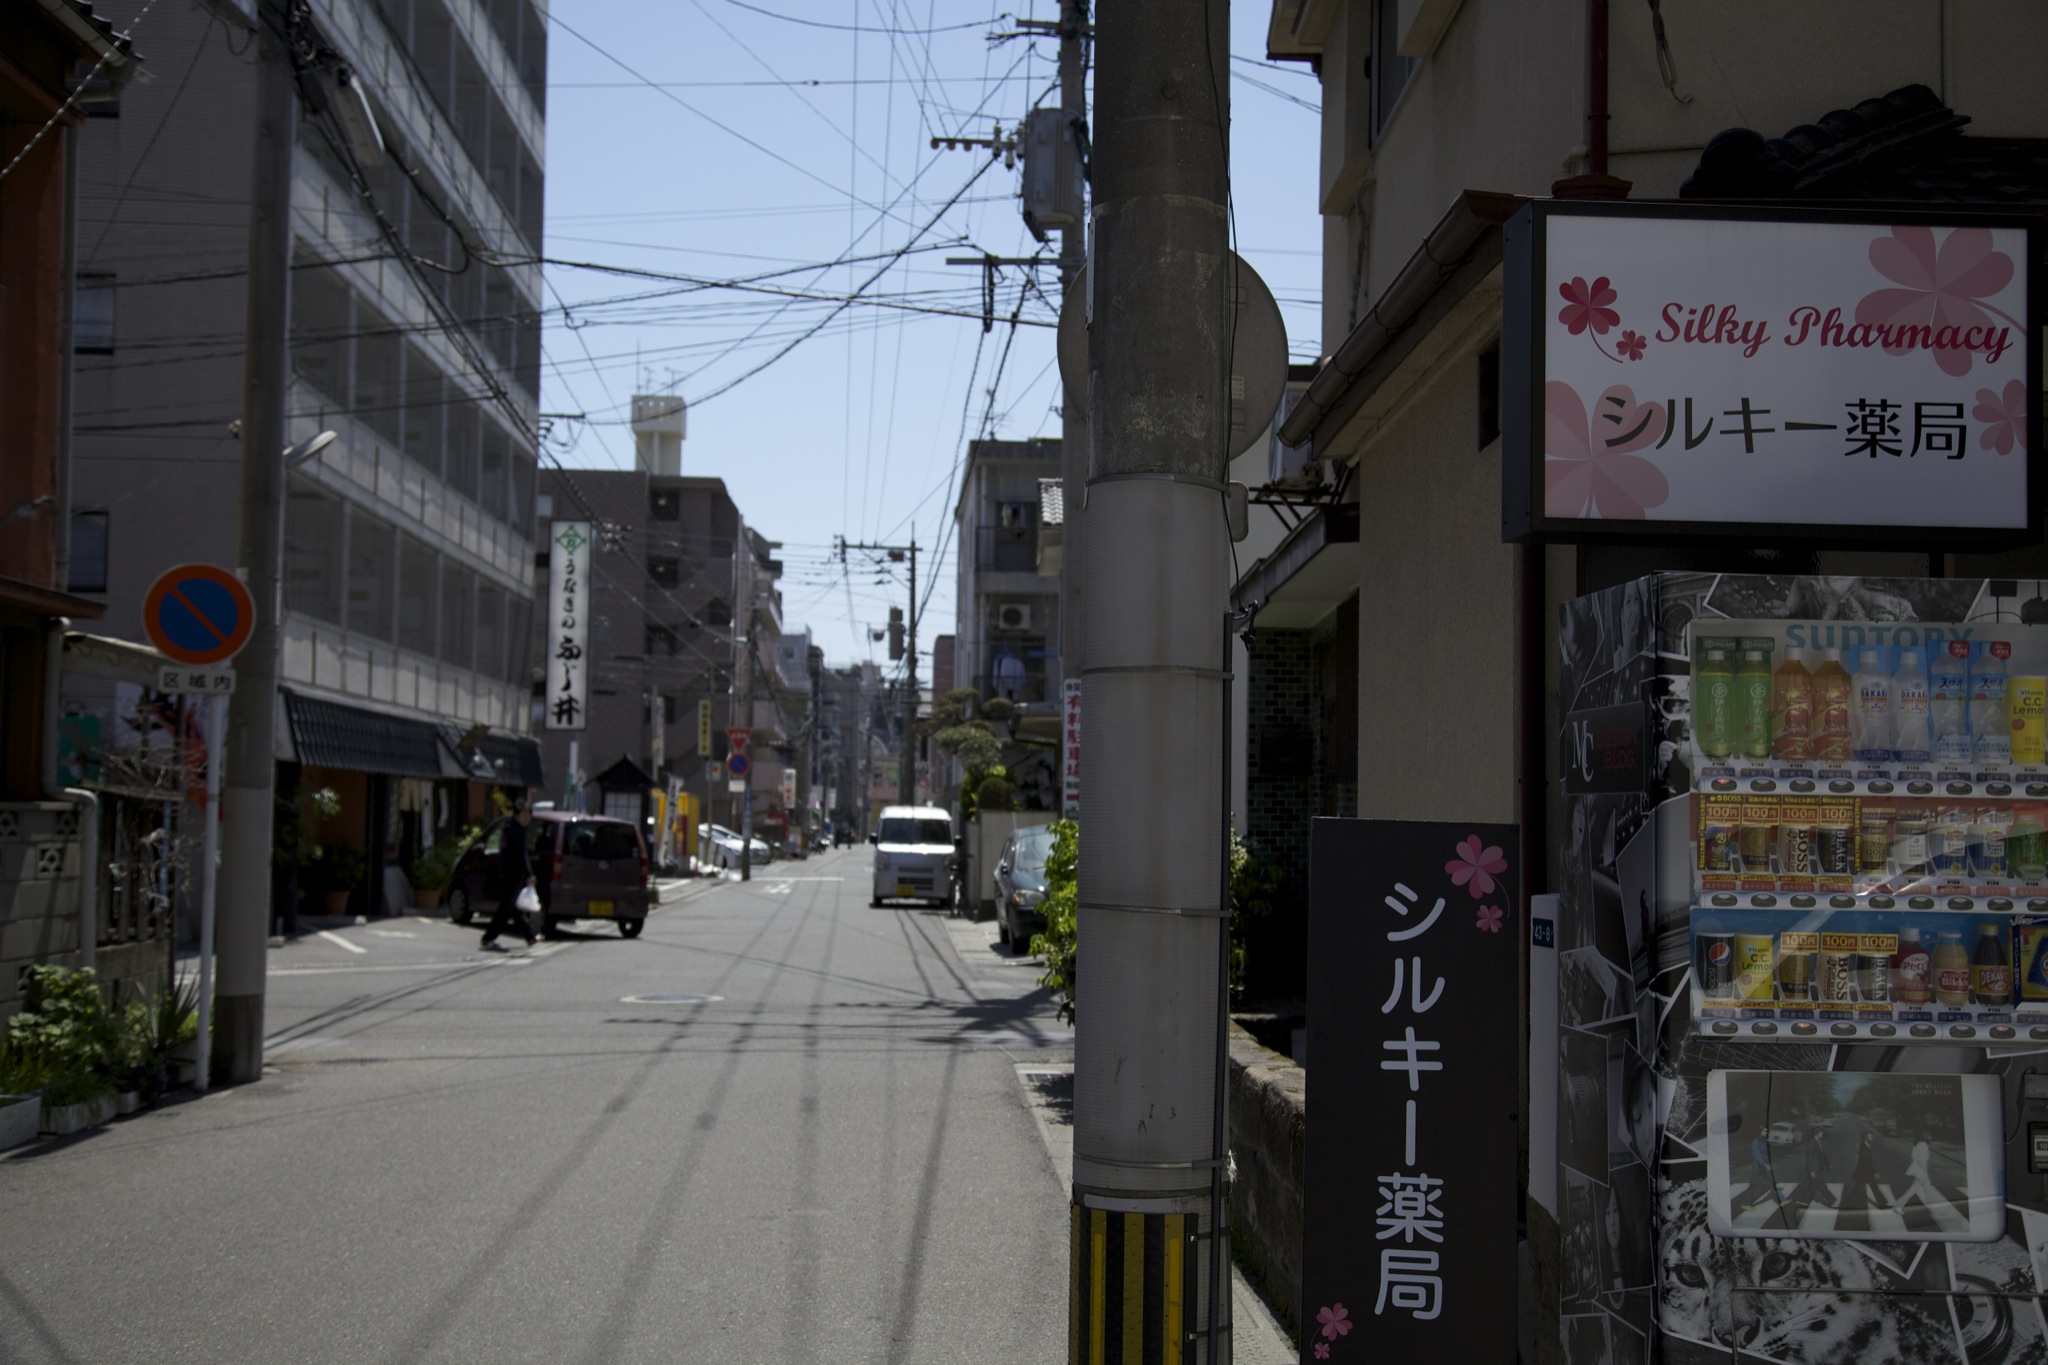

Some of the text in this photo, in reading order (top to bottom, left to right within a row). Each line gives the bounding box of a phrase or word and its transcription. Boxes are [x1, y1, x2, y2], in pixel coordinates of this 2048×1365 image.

[1655, 302, 2013, 364] Silky Pharmacy
[1603, 396, 1968, 461] シルキー薬局
[163, 671, 231, 690] 区域内
[1595, 727, 1639, 748] DESIGN
[1707, 807, 1738, 817] 100円
[1746, 808, 1777, 817] 100円
[1785, 808, 1816, 818] 100円
[1796, 829, 1808, 873] BOSS
[1836, 829, 1847, 871] BLACK
[1534, 924, 1551, 942] 43-8
[1784, 935, 1816, 946] 100円
[1824, 936, 1856, 946] 100円
[1863, 936, 1896, 947] 100円
[1750, 954, 1769, 963] C.C.
[1836, 957, 1848, 1000] BOSS
[1875, 957, 1887, 999] BLACK
[1373, 881, 1446, 1321] シルキー薬局
